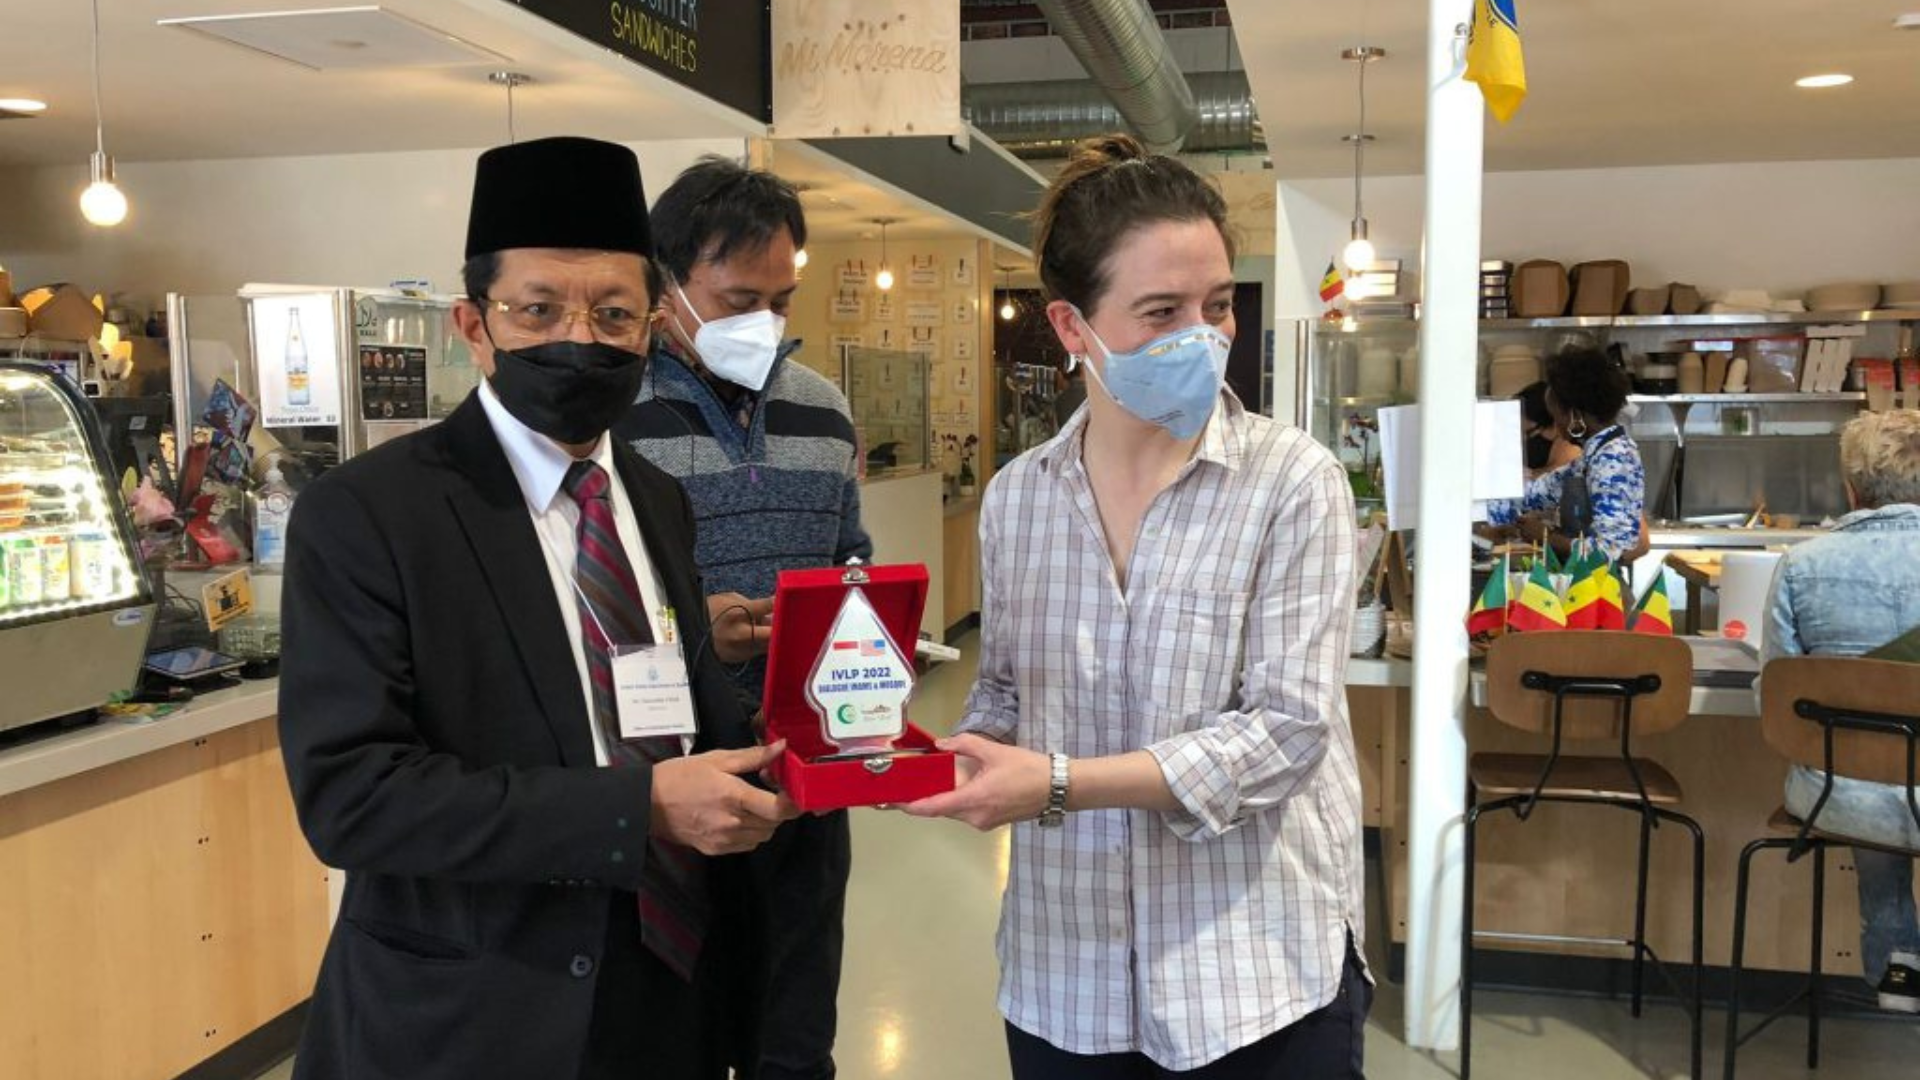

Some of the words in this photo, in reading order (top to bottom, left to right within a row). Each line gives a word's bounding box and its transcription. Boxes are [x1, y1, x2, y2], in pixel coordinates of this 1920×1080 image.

[610, 1, 697, 72] SANDWICHES
[825, 24, 947, 74] Morena
[266, 415, 296, 424] Mineral
[298, 415, 321, 423] Water
[832, 669, 859, 680] IVLP
[863, 667, 891, 678] 2022
[819, 684, 848, 693] DIALOGUE
[850, 682, 872, 691] IMAMS
